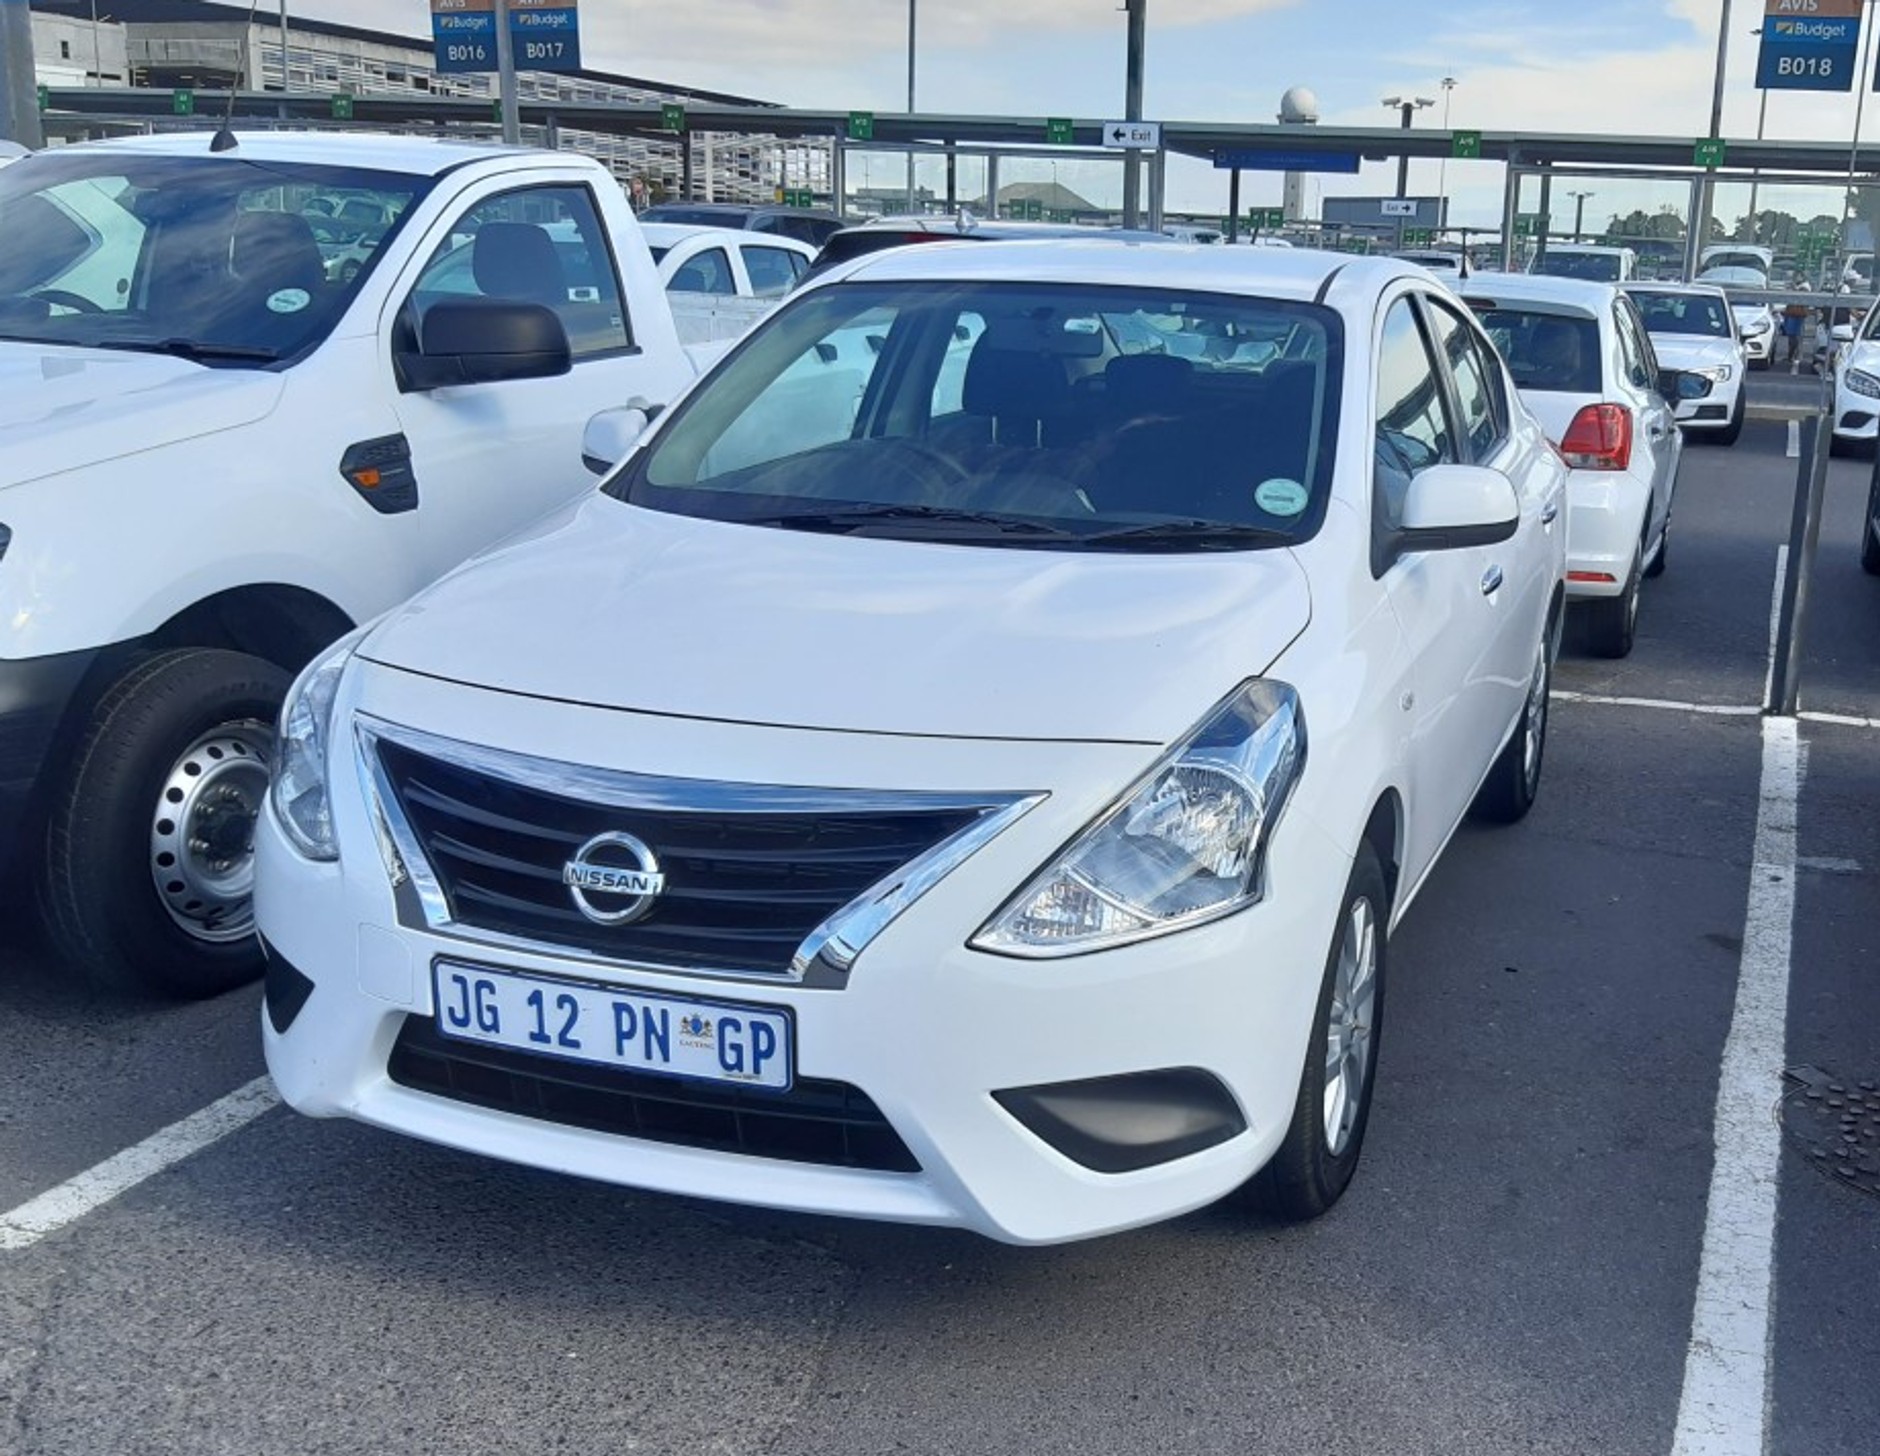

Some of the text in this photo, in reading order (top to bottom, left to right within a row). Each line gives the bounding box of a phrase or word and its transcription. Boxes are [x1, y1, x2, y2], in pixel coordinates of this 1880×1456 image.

[453, 15, 488, 30] Budget
[531, 12, 568, 28] Budget
[1795, 22, 1846, 40] Budget
[448, 44, 486, 61] B016
[526, 42, 564, 59] B017
[1778, 57, 1832, 77] B018
[1131, 129, 1151, 142] Exit
[570, 866, 649, 891] NISSAN
[447, 974, 777, 1075] JG 12 PN GP
